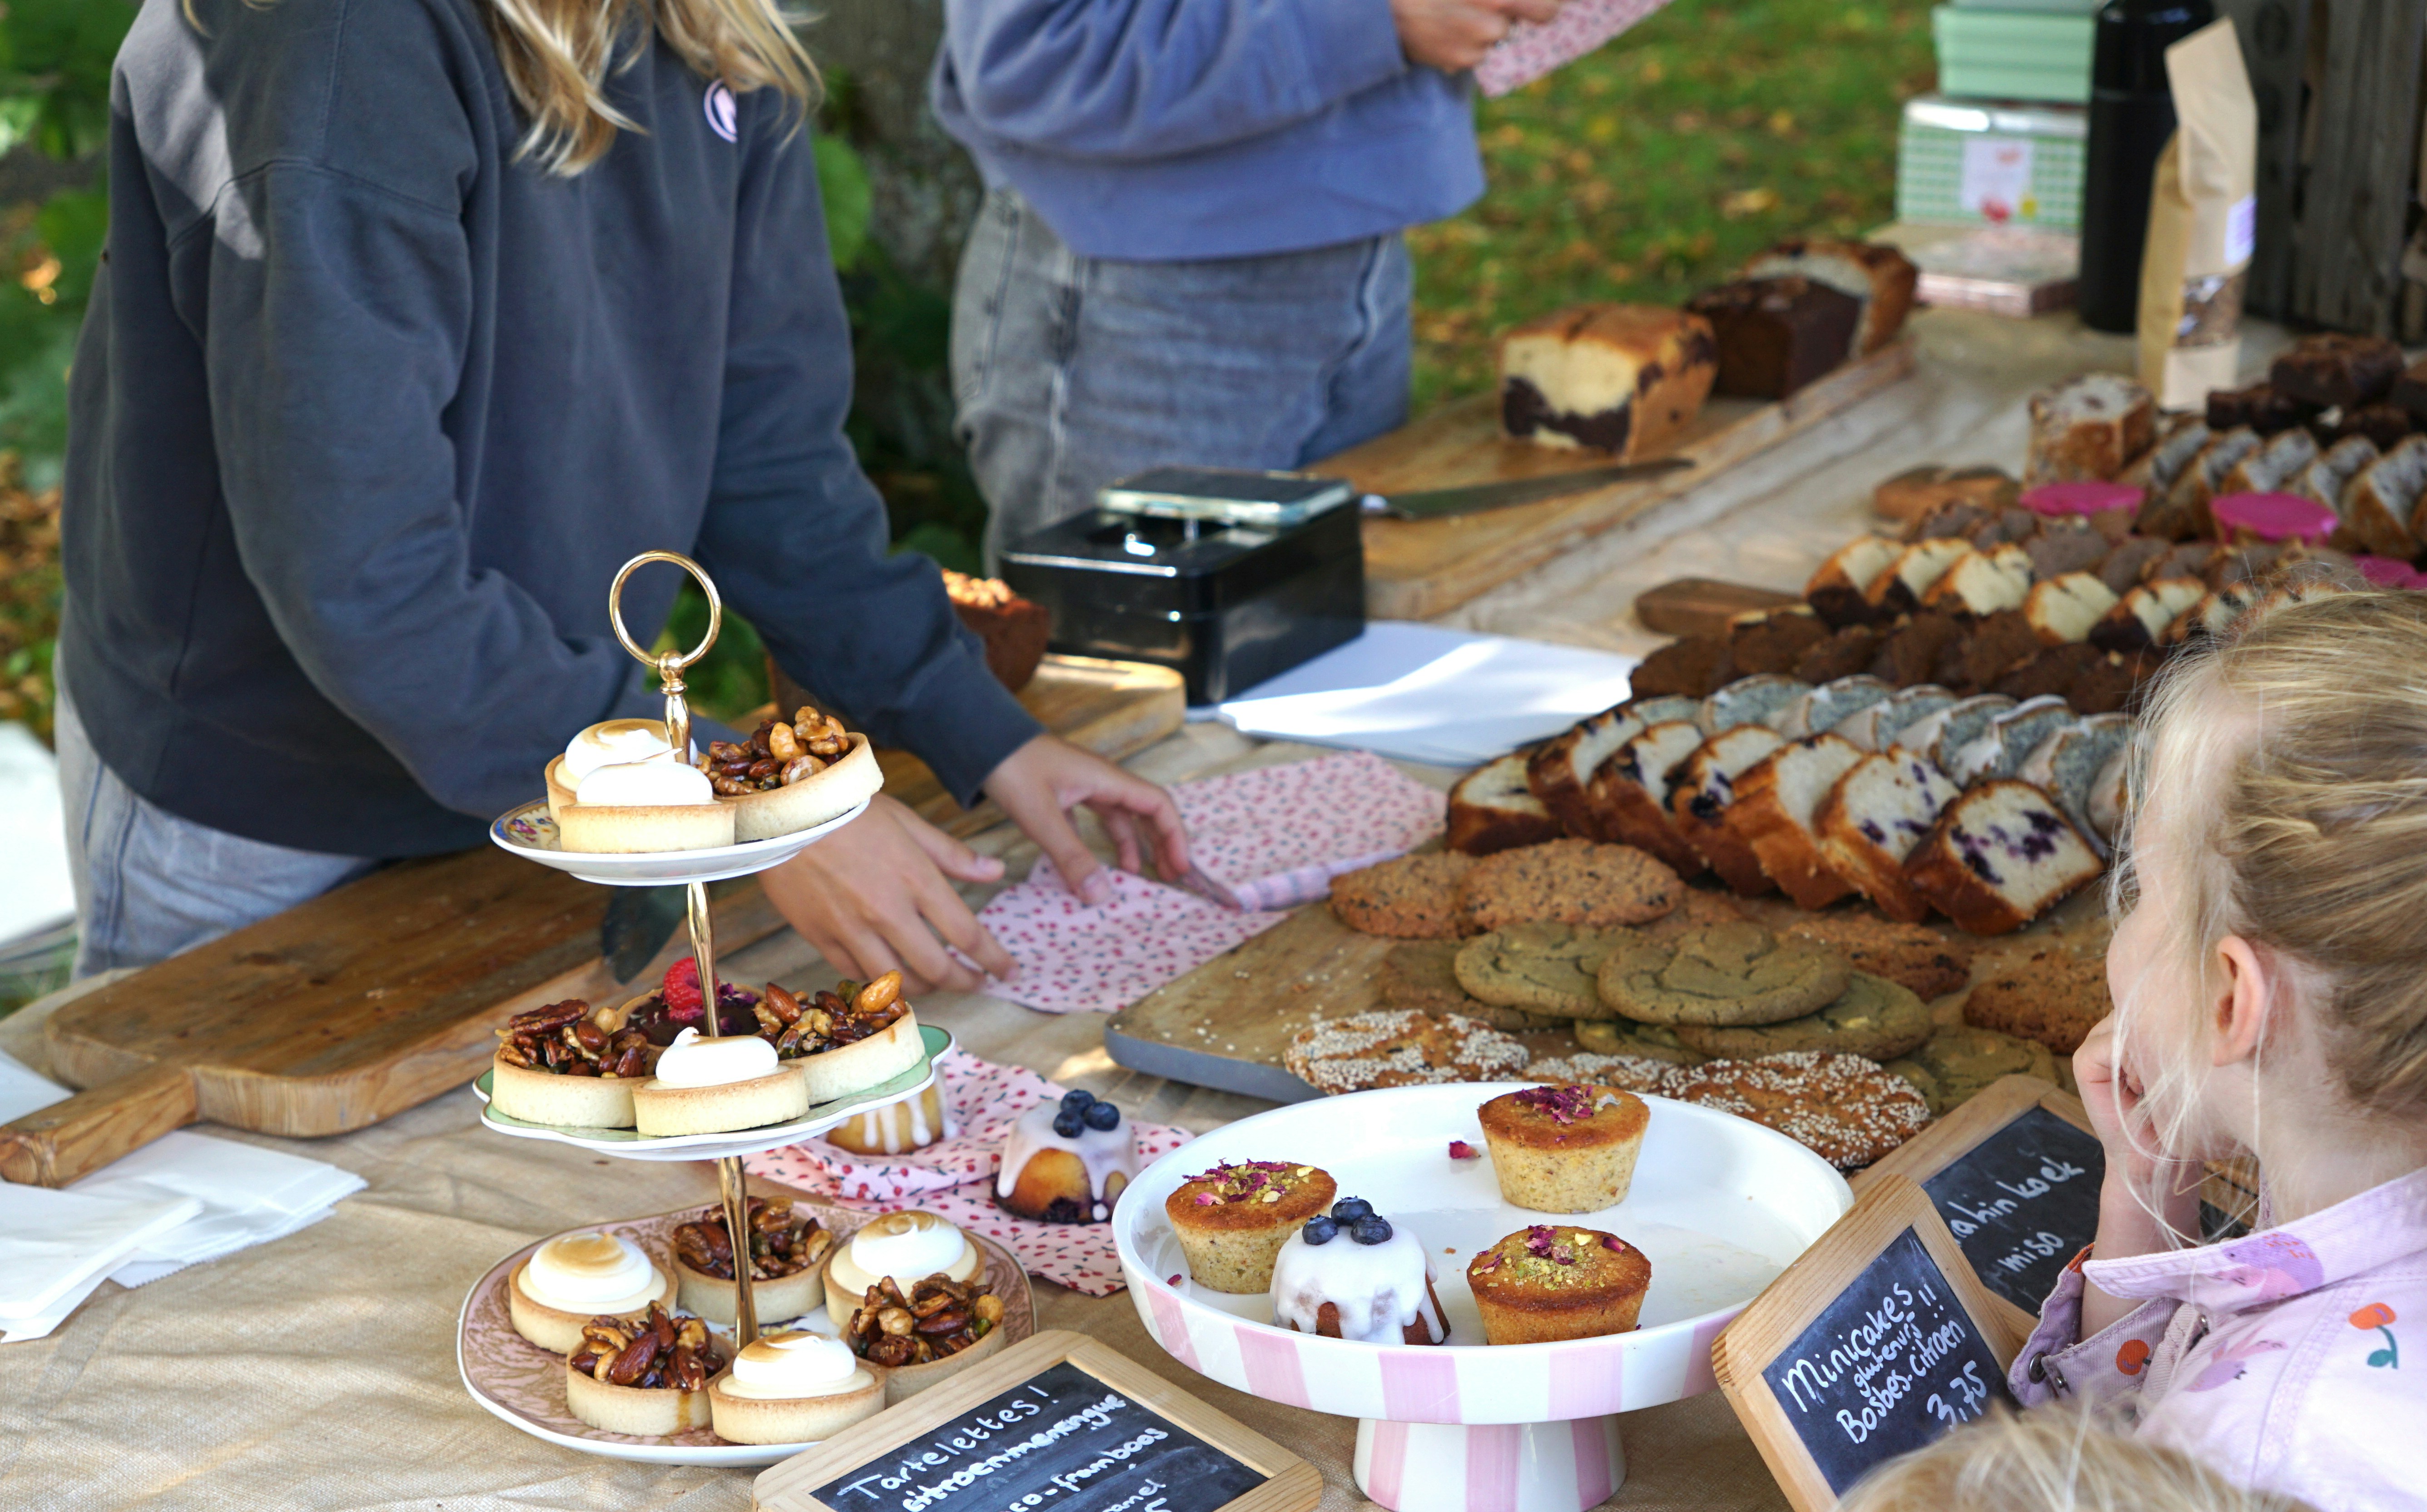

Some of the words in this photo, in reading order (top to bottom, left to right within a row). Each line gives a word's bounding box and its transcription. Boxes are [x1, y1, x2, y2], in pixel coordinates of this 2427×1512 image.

[1948, 1199, 2018, 1247] ahin
[1997, 1231, 2065, 1272] miso
[1927, 1360, 1987, 1433] 3,75
[837, 1385, 1059, 1499] Tartelettes!
[1002, 1428, 1168, 1512] co-framboos
